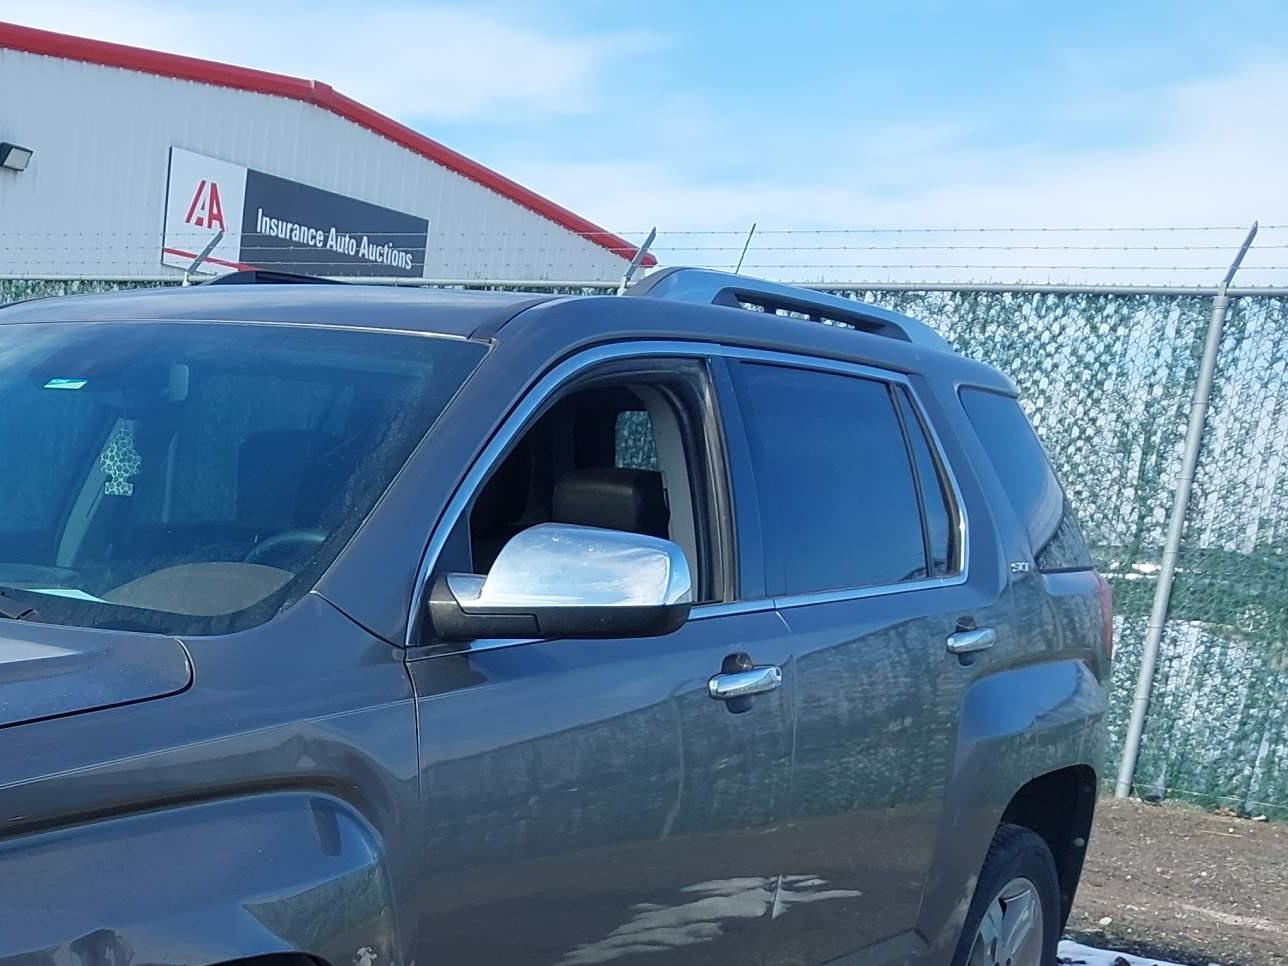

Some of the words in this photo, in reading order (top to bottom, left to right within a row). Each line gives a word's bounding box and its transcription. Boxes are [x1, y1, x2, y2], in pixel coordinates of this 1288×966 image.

[256, 207, 324, 249] Insurance
[326, 226, 358, 256] Auto
[358, 235, 413, 271] Auctions
